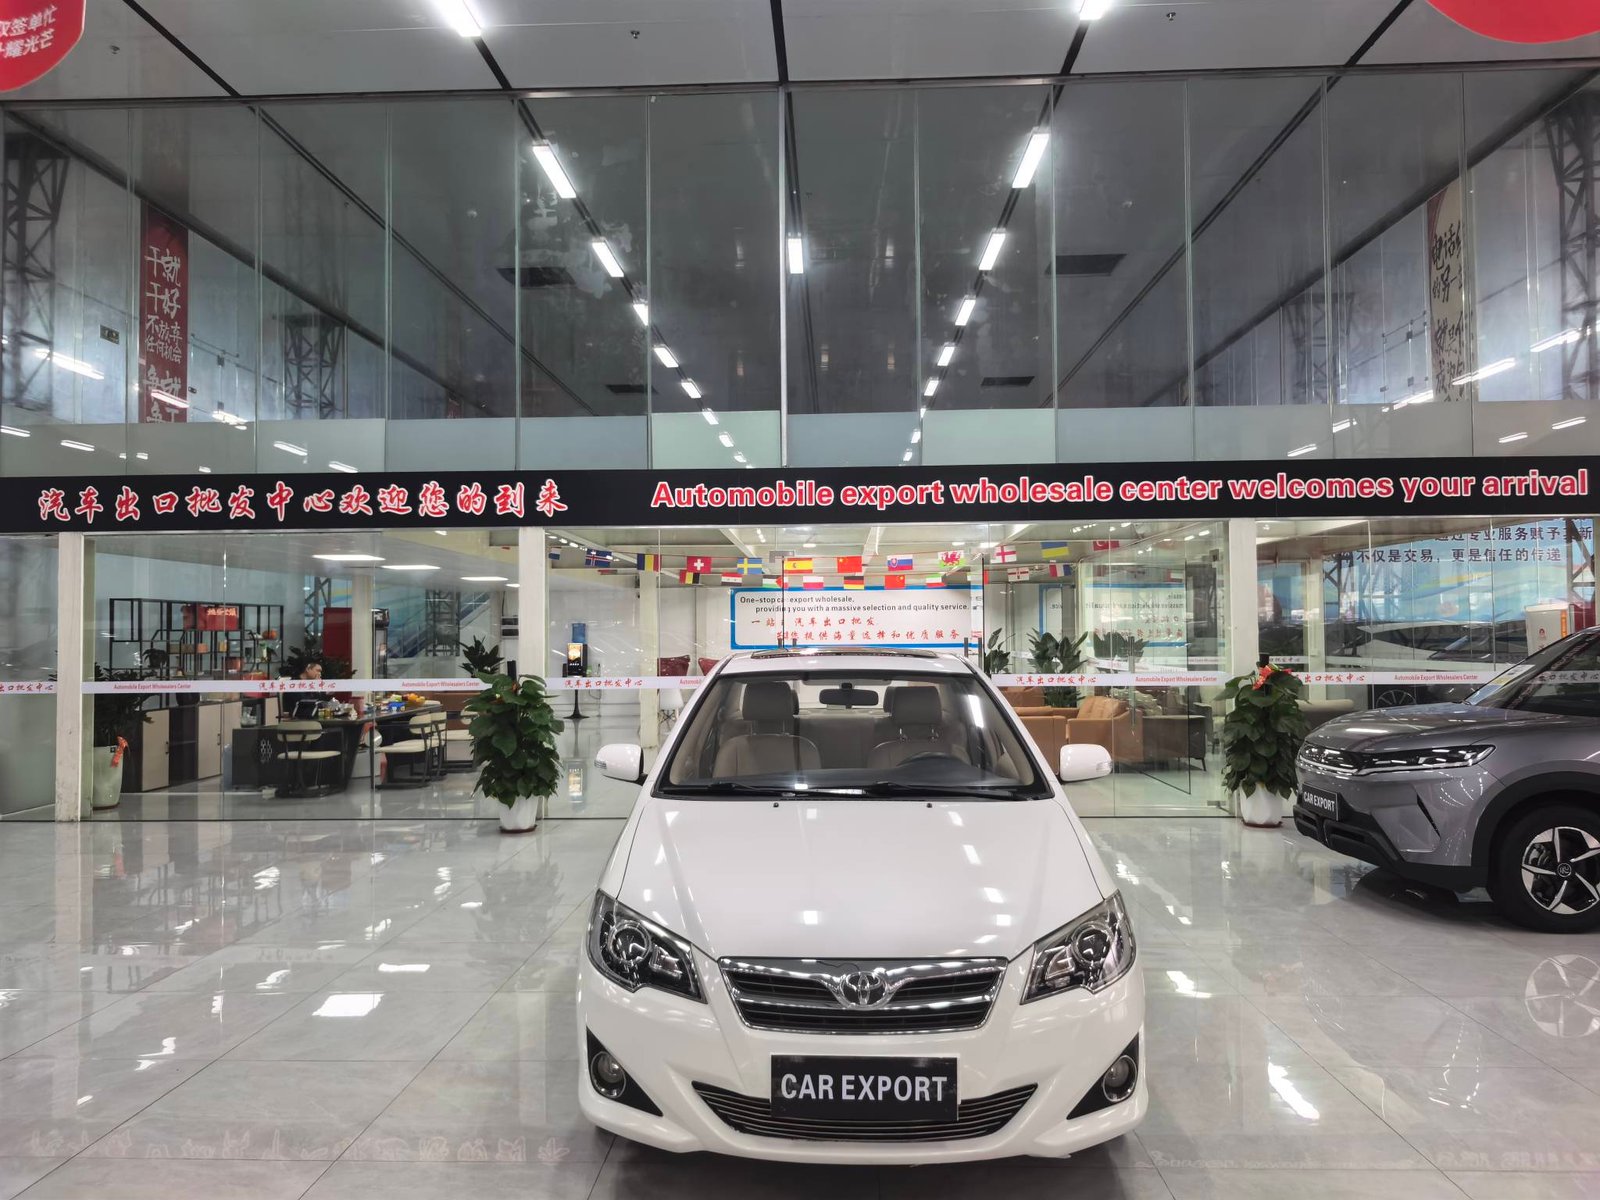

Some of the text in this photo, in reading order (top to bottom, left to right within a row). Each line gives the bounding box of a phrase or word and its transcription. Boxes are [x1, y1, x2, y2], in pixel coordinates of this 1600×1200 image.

[650, 468, 1588, 511] Automobile export wholesale center welcomes your arrival
[37, 479, 569, 522] 汽车出口批发中心欢迎您的到来
[740, 596, 776, 604] One-stop
[913, 603, 938, 612] quality
[564, 678, 643, 688] 汽车出口批发中心
[1015, 674, 1097, 685] 汽车出口批发中心
[1303, 791, 1335, 812] CAR EXPORT
[780, 1073, 948, 1102] CAR EXPORT
